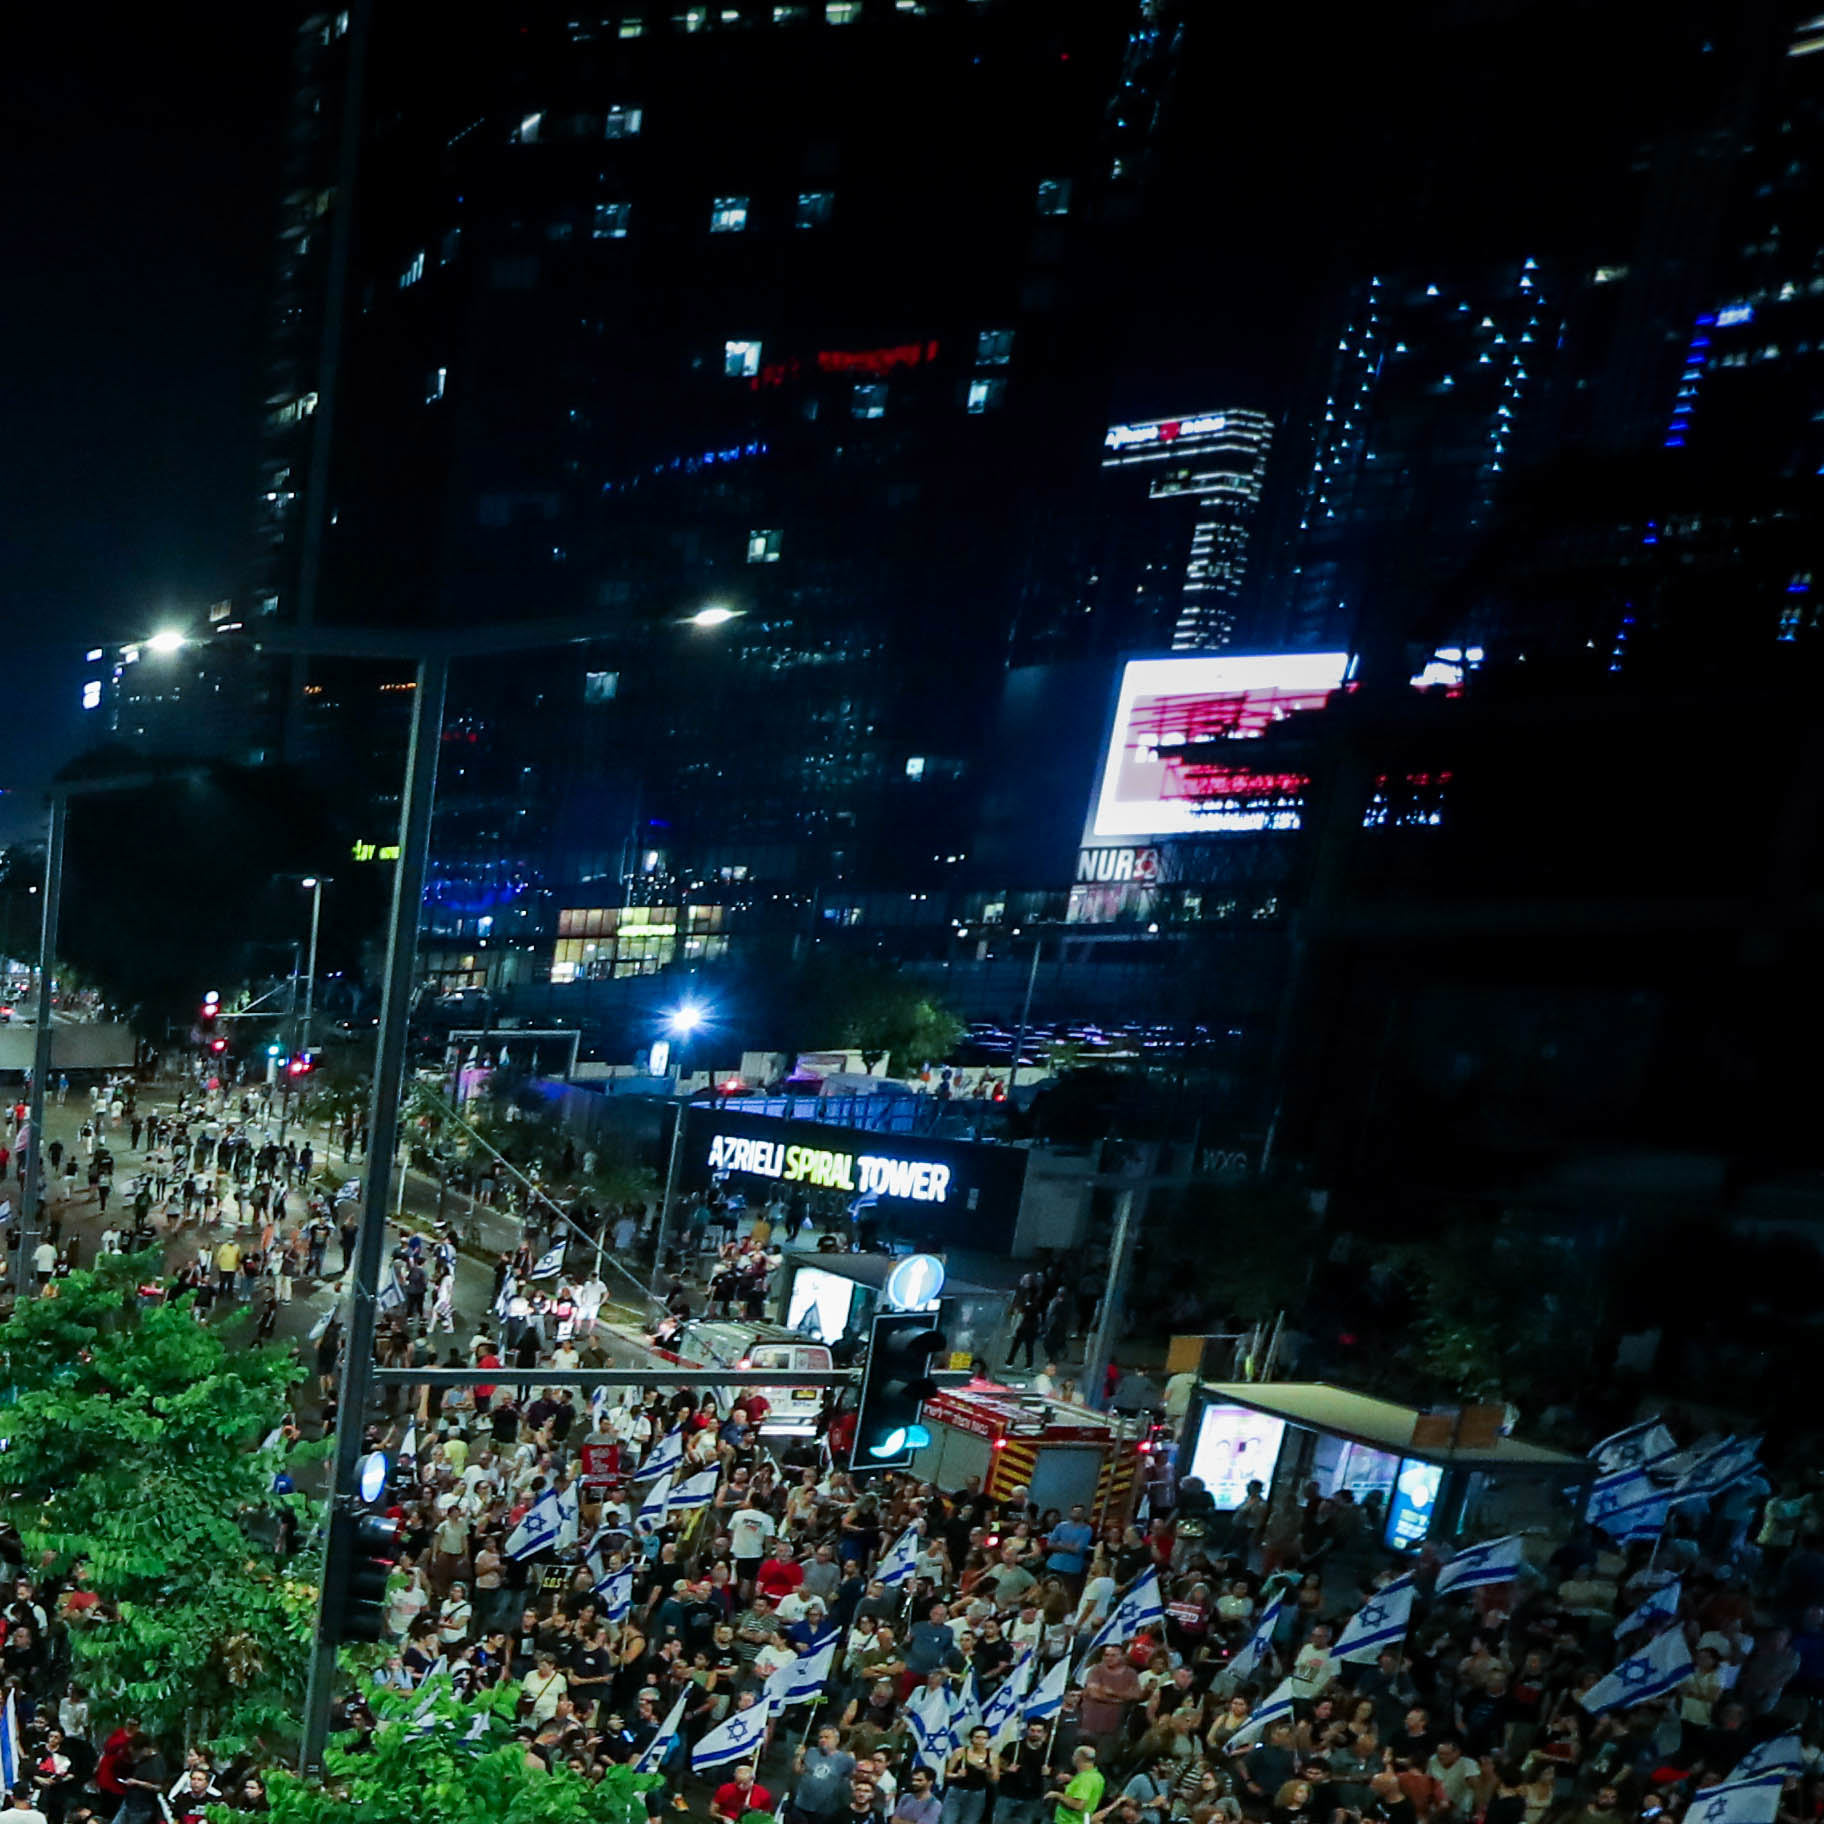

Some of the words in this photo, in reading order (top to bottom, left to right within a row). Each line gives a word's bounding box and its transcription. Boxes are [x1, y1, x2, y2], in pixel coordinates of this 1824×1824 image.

[708, 1135, 785, 1177] AZRIELI
[783, 1145, 854, 1190] SPIRAL
[857, 1155, 950, 1204] TOWER
